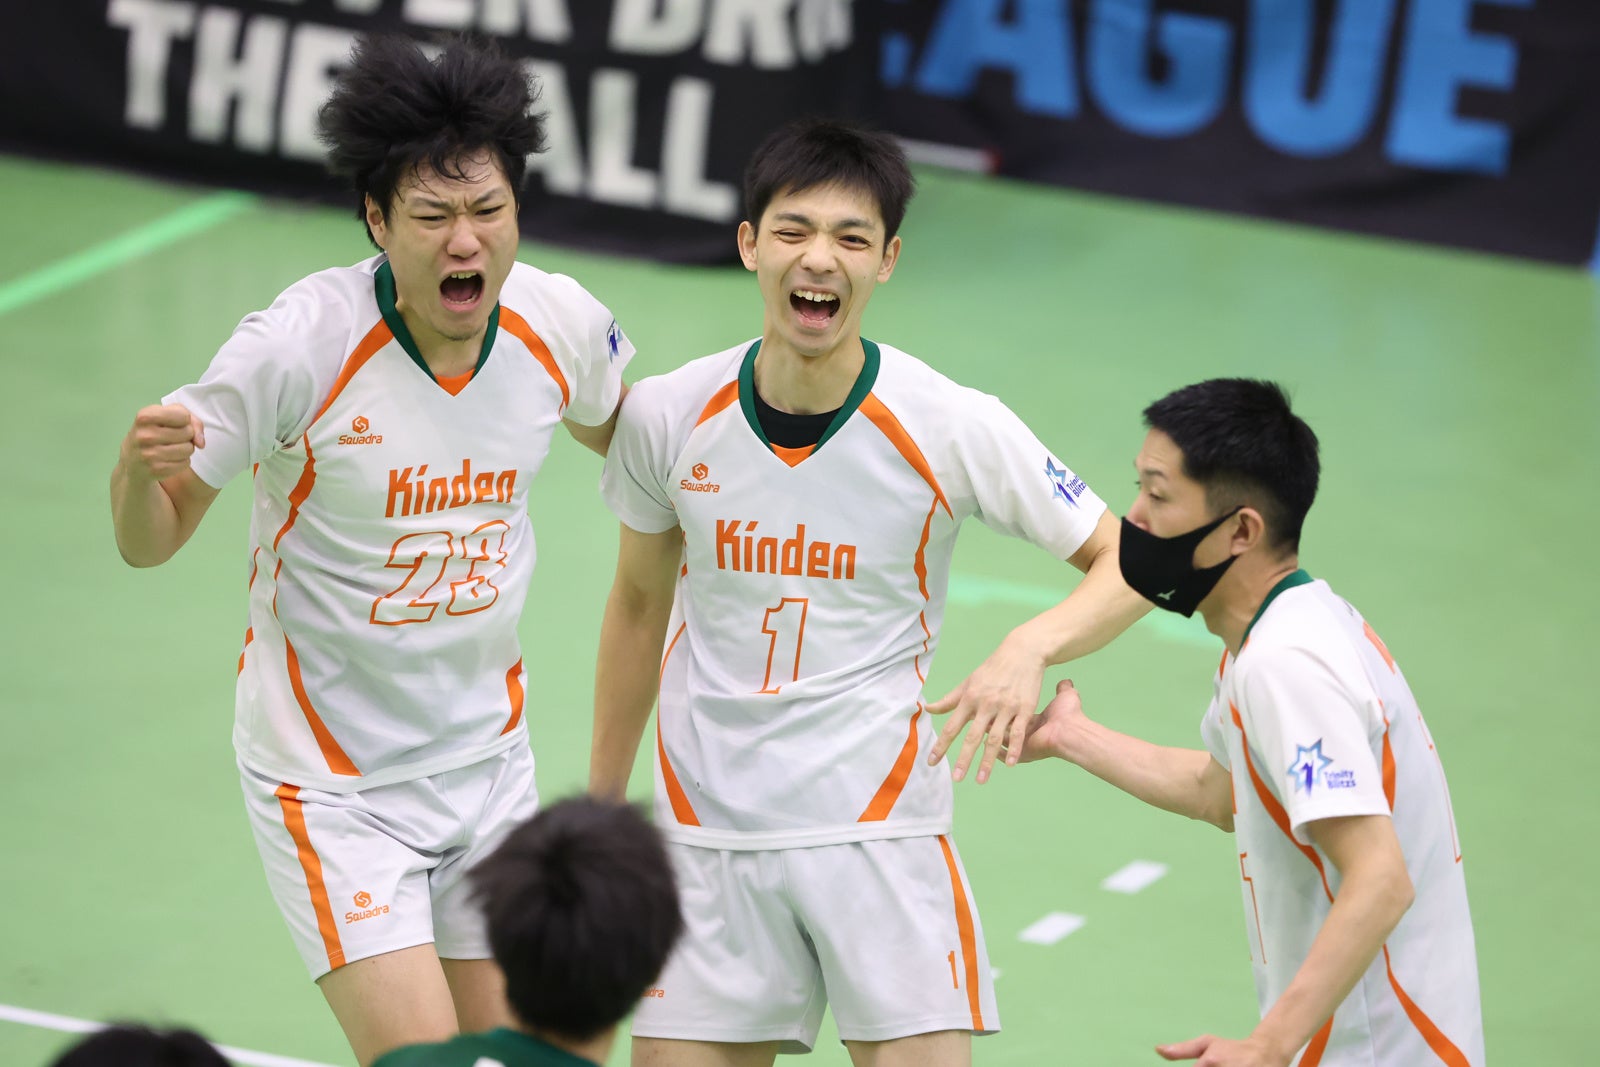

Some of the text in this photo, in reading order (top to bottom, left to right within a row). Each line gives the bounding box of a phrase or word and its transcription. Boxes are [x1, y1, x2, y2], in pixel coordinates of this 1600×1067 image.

[880, 0, 1533, 177] AGUE
[520, 58, 740, 225] ALL
[338, 433, 383, 445] Squadra
[384, 458, 517, 518] Kinden
[680, 479, 720, 493] Squadra
[715, 518, 857, 580] Kinden
[758, 597, 809, 694] 1
[345, 904, 390, 924] Squadra
[947, 950, 959, 989] 1
